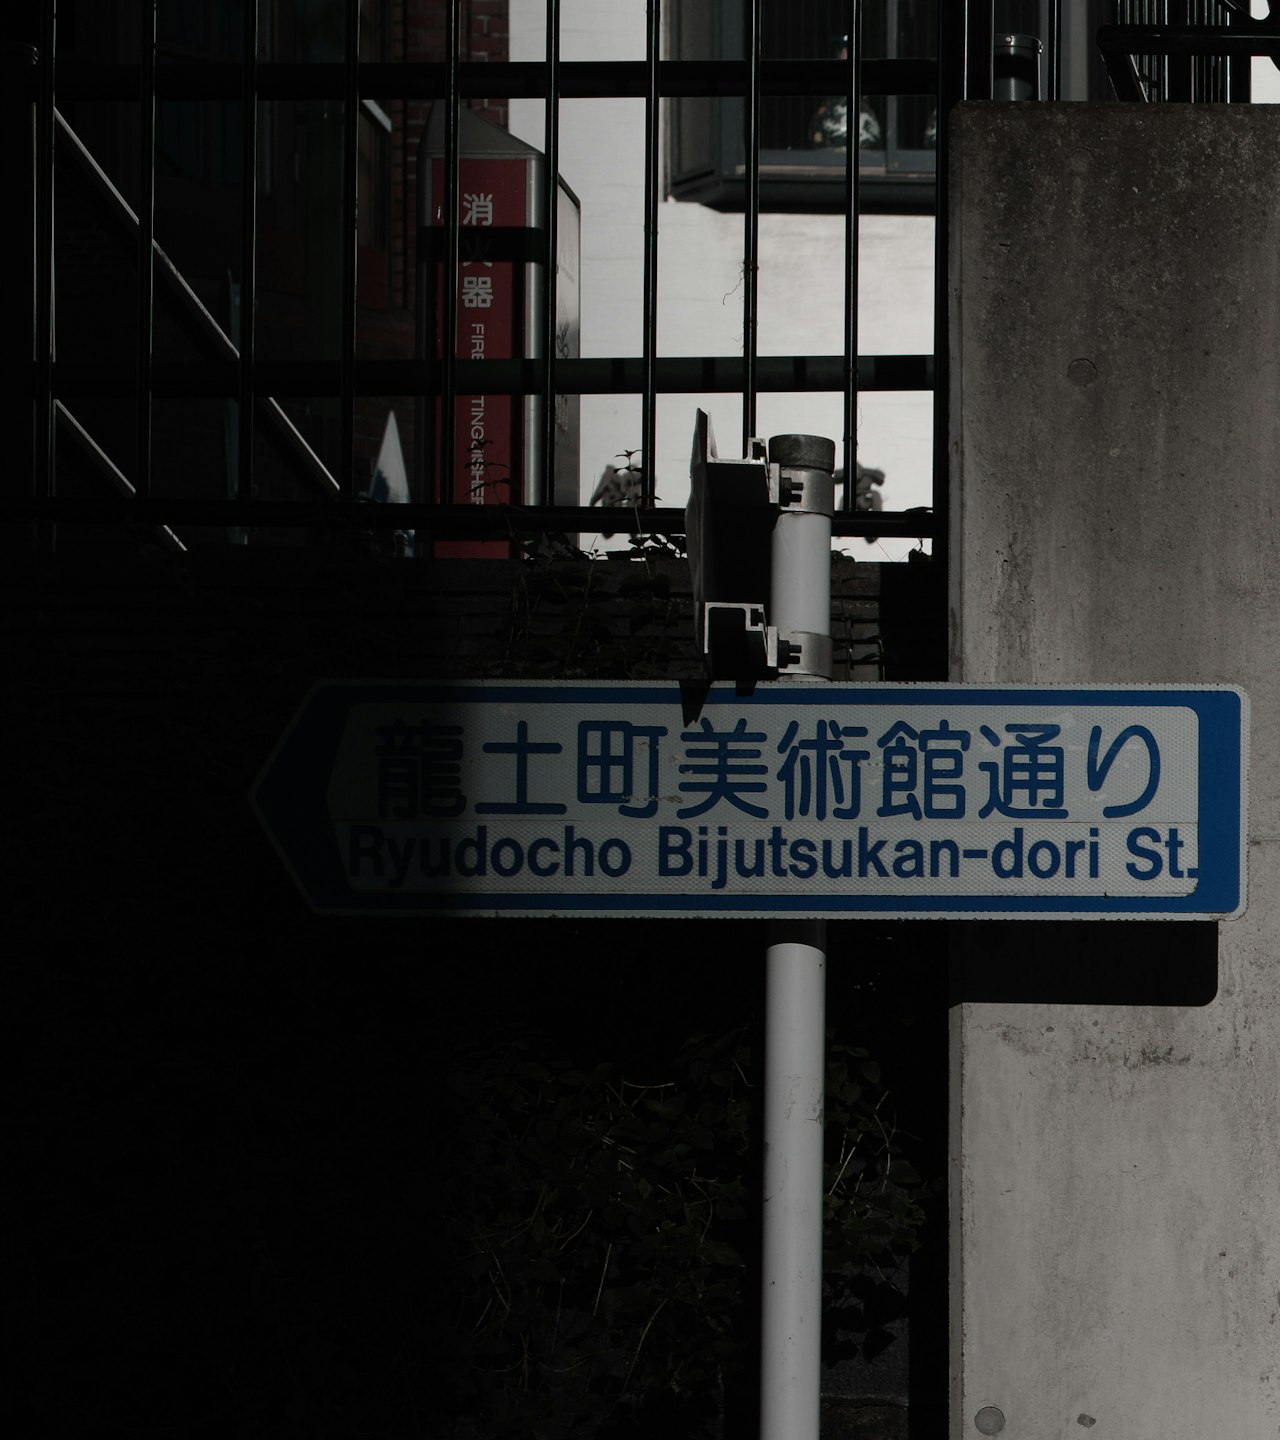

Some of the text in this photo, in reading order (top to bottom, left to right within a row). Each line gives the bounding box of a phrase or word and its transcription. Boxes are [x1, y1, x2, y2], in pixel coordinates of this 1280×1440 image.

[471, 323, 485, 360] FIRE
[374, 717, 1162, 821] 龍土町美術館通り
[348, 825, 1200, 890] Ryudocho Bijutsukan-dori St.
